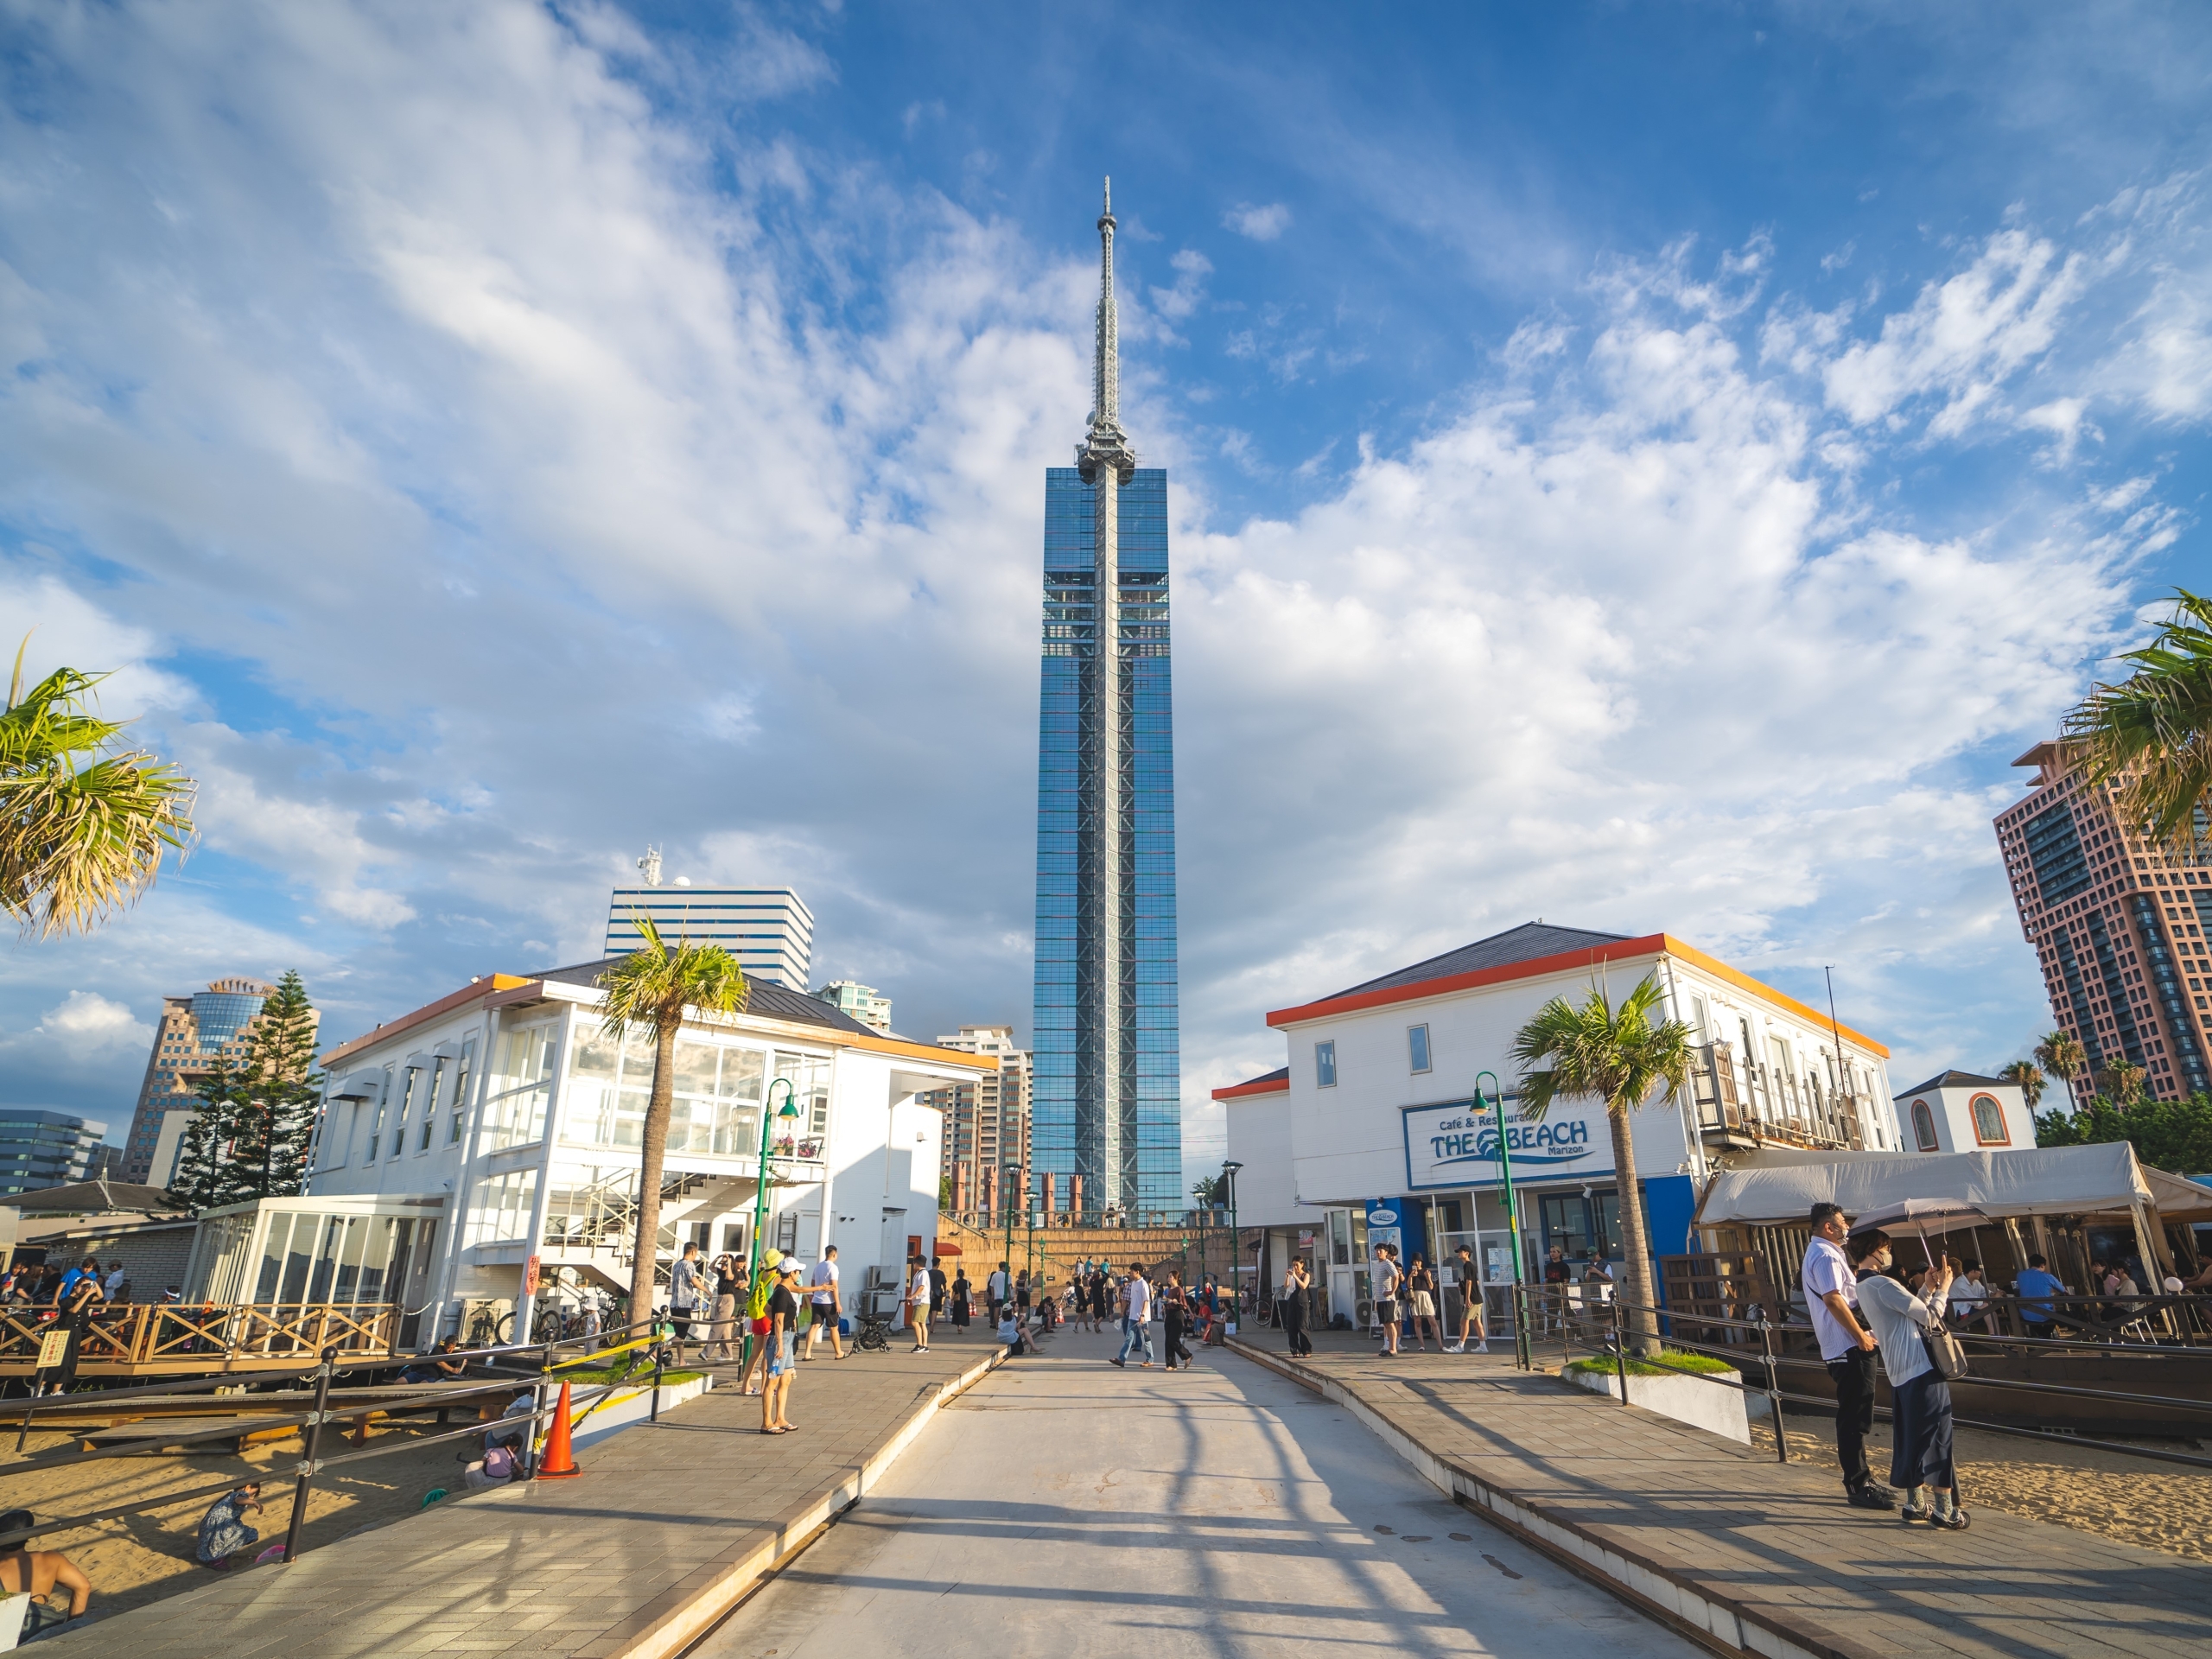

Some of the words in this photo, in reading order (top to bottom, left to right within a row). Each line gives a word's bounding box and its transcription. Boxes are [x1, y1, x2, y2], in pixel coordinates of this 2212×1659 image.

[1440, 1116, 1462, 1130] Café
[1465, 1117, 1475, 1128] &
[1430, 1133, 1476, 1158] THE
[1506, 1121, 1588, 1150] BEACH
[1548, 1146, 1584, 1156] Marizon
